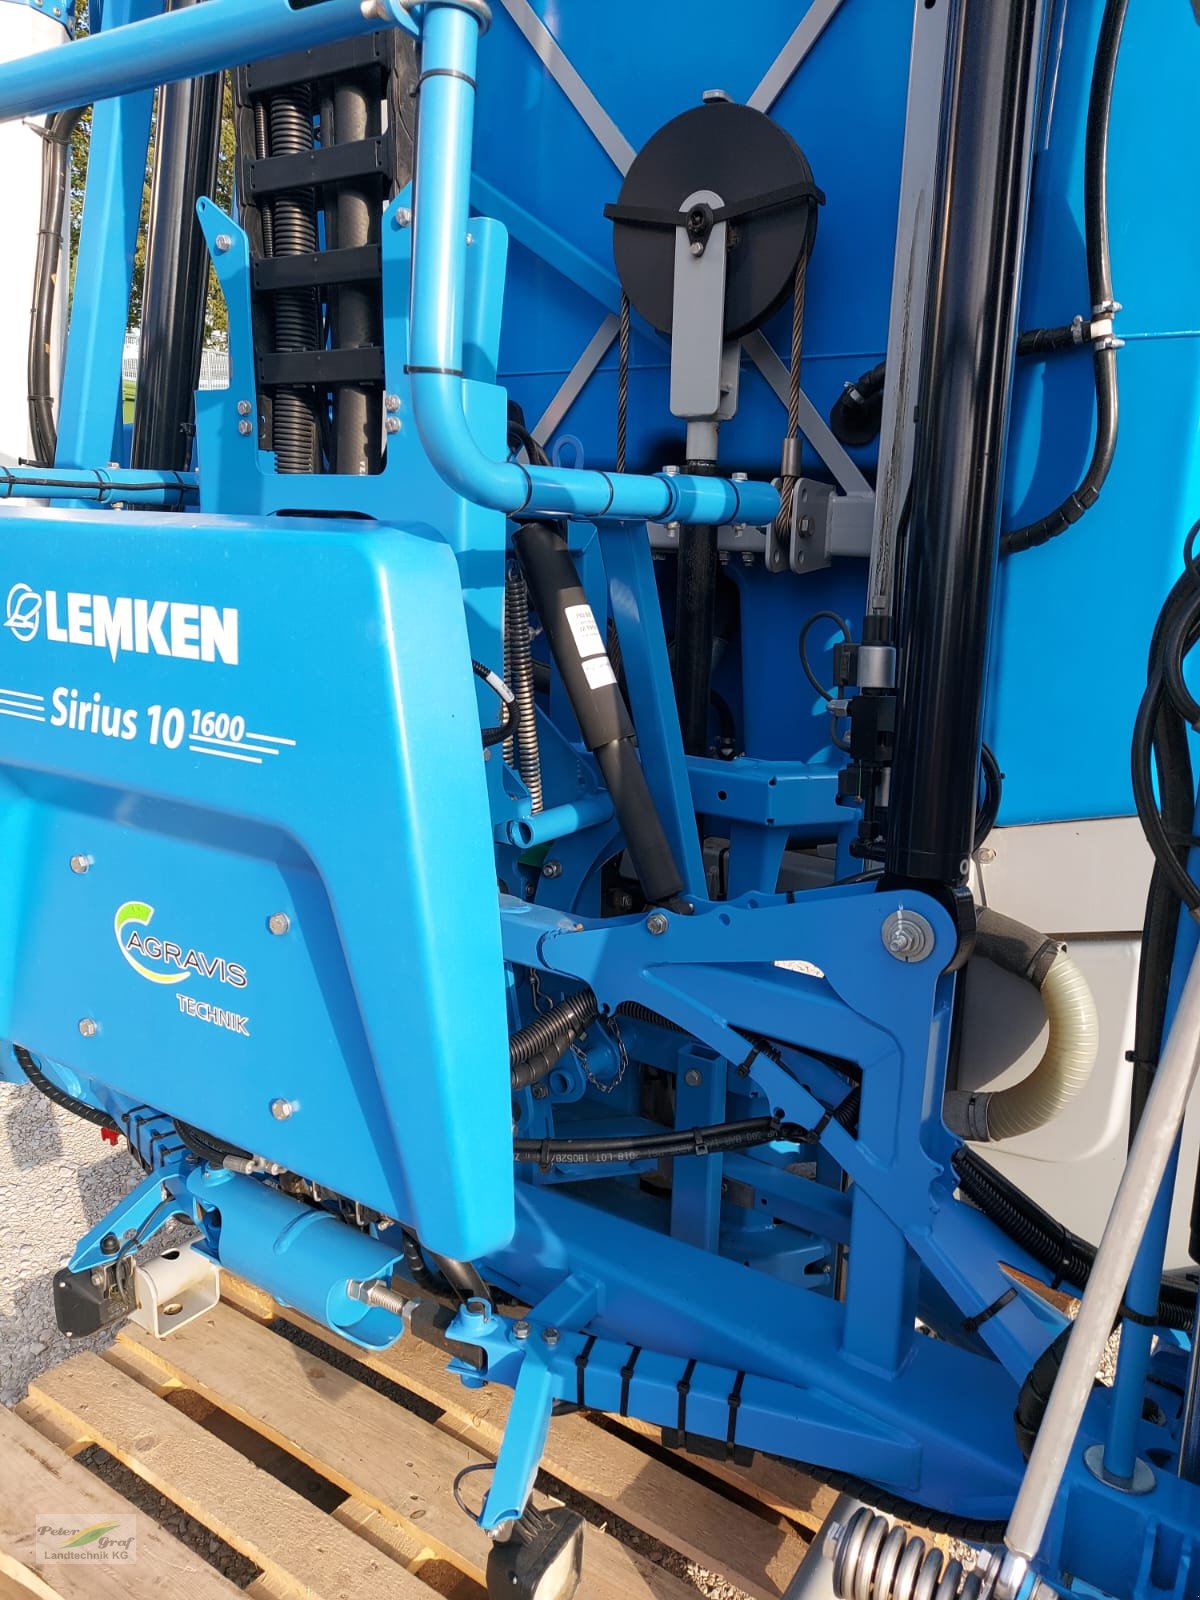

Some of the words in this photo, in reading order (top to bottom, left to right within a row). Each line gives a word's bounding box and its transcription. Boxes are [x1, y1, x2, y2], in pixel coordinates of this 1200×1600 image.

[45, 590, 239, 665] LEMKEN
[50, 686, 138, 740] Sirius
[147, 704, 185, 749] 10
[190, 708, 245, 742] 1600
[126, 931, 248, 988] AGRAVIS
[176, 993, 250, 1036] TECHNIK
